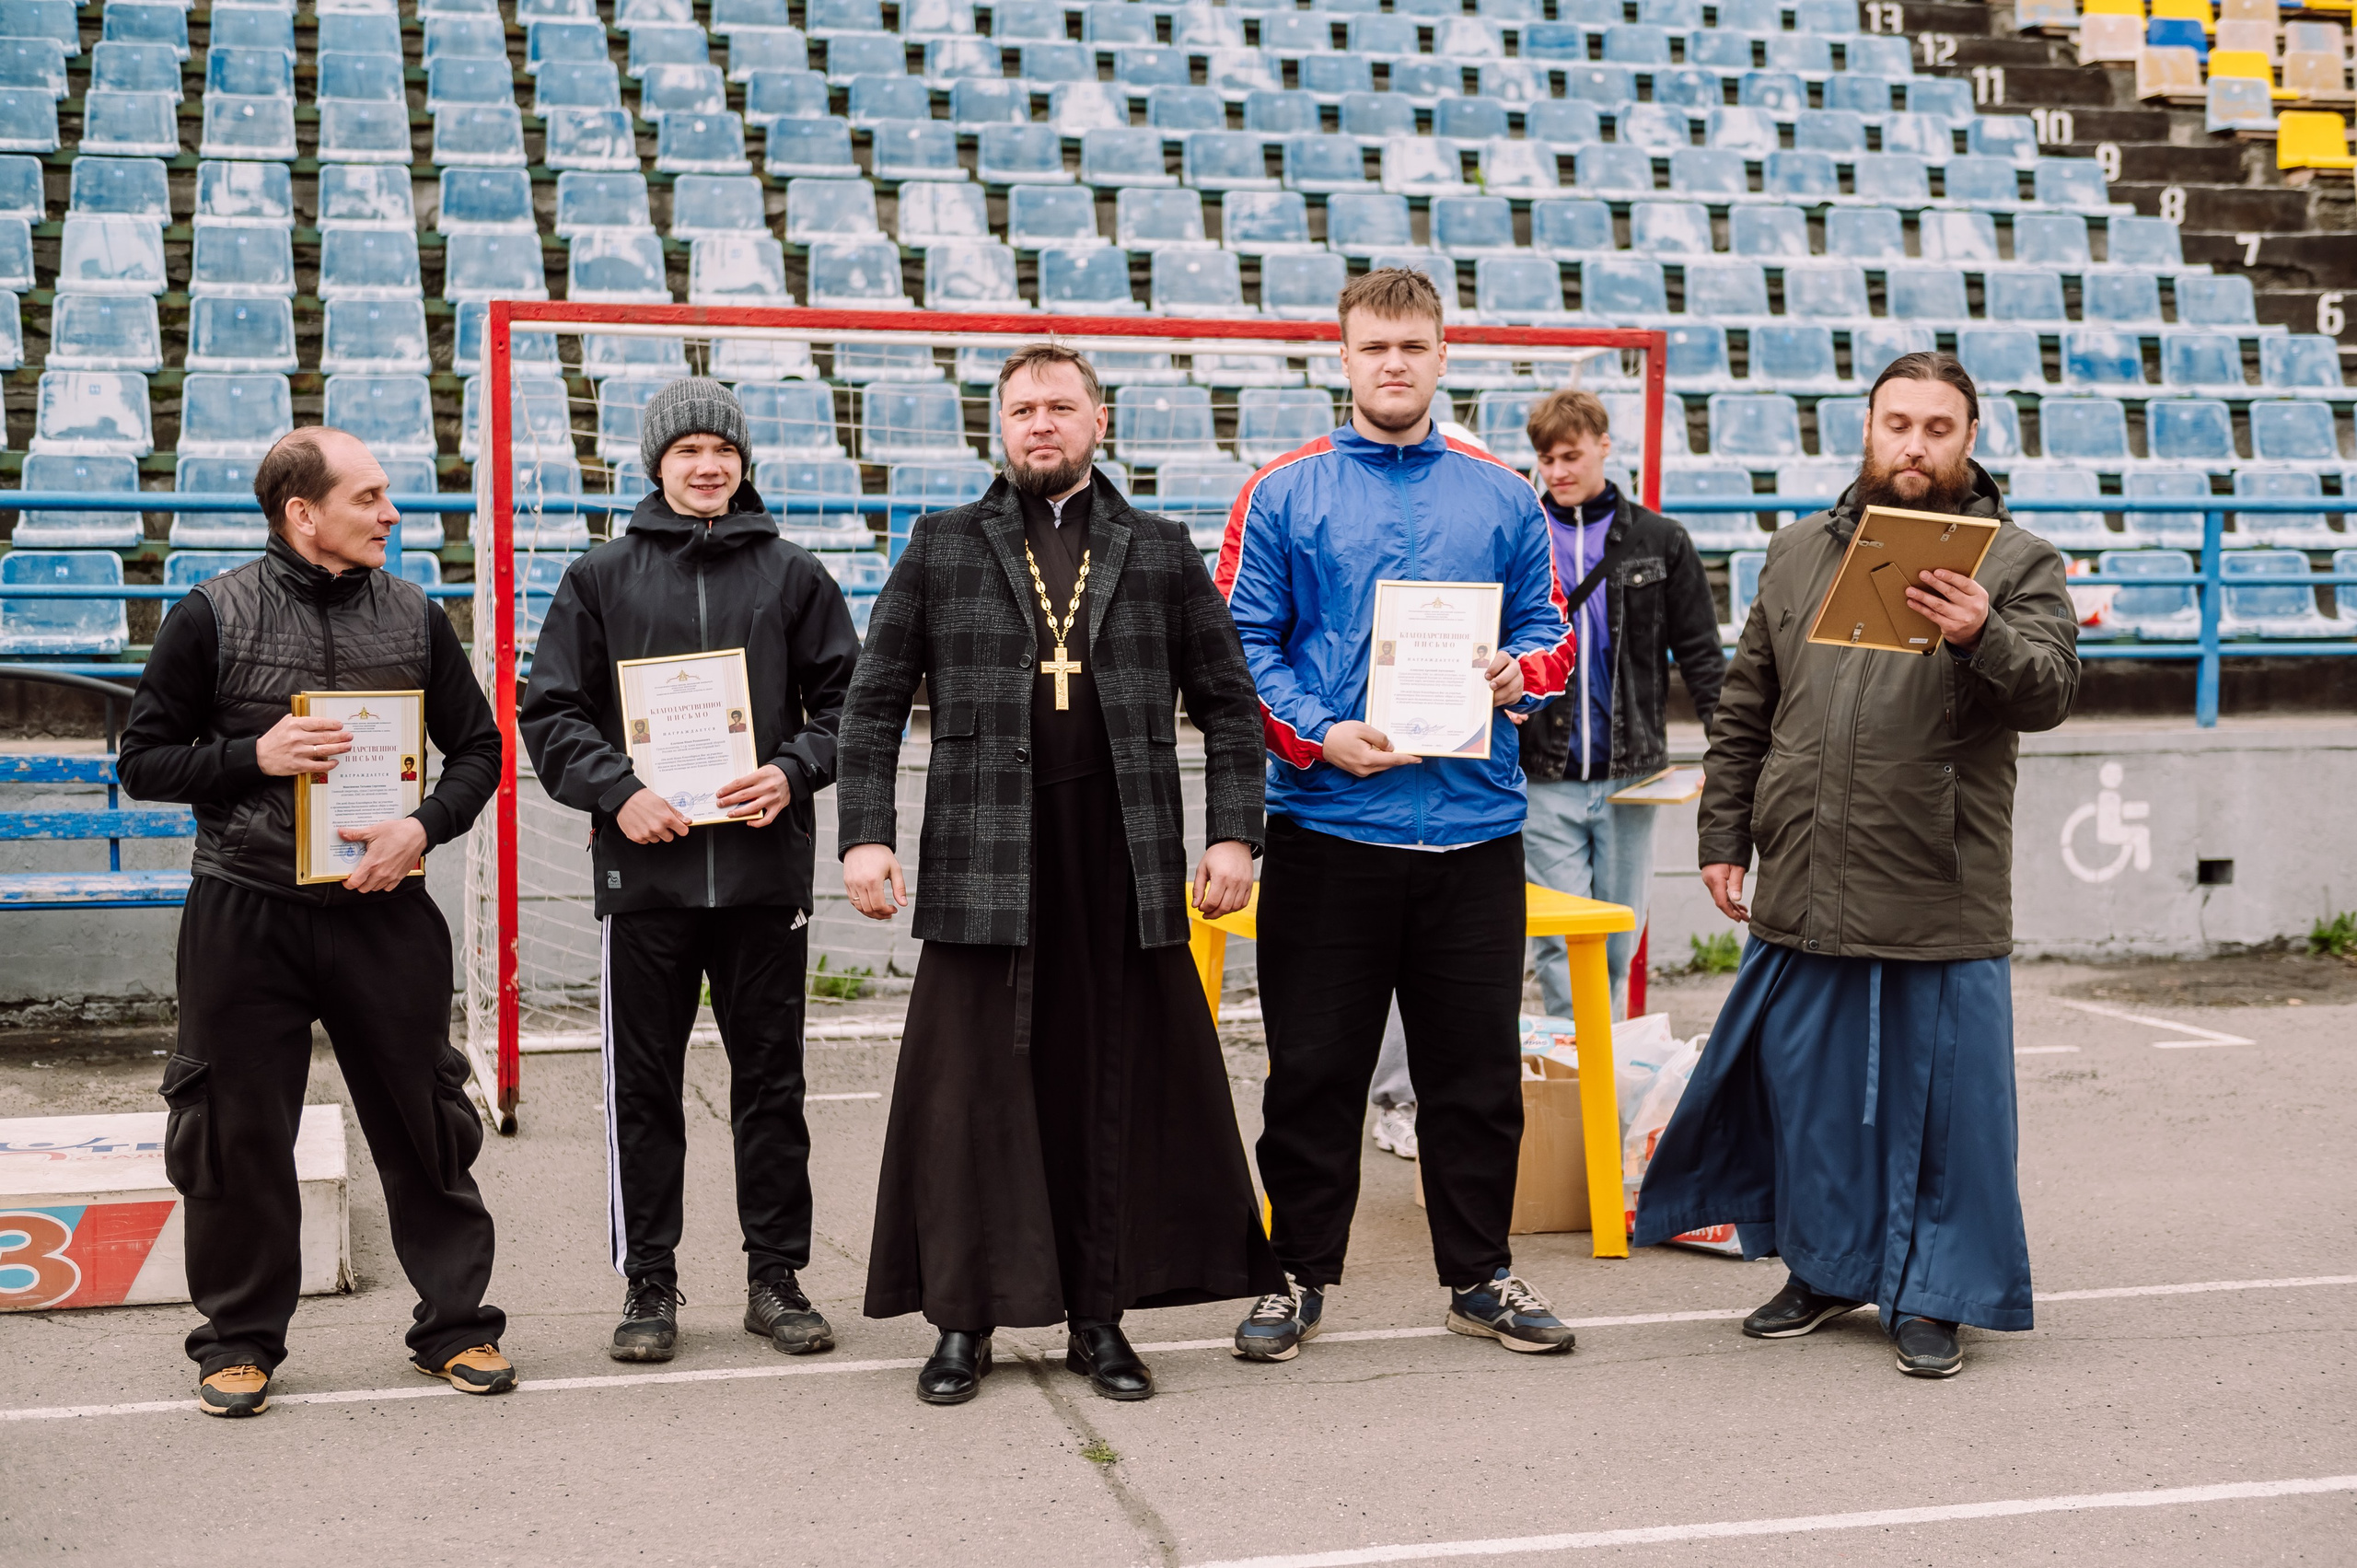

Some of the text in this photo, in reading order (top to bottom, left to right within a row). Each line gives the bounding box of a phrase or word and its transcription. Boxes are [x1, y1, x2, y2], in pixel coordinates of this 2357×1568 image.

[1866, 2, 1904, 34] 13
[1918, 32, 1958, 66] 12
[1972, 65, 2005, 105] 11
[2031, 108, 2073, 145] 10
[2096, 142, 2122, 182] 9
[2159, 186, 2187, 226] 8
[2235, 233, 2263, 267] 7
[2316, 293, 2345, 336] 6
[1399, 632, 1470, 641] БЛАГОДАРСТВЕННОЕ
[650, 701, 723, 715] БЛАГОДАРСТВЕННОЕ
[667, 712, 709, 722] ПИСЬМО
[345, 754, 384, 762] ПИСЬМО
[351, 745, 399, 753] ДАРСТВЕННОЕ
